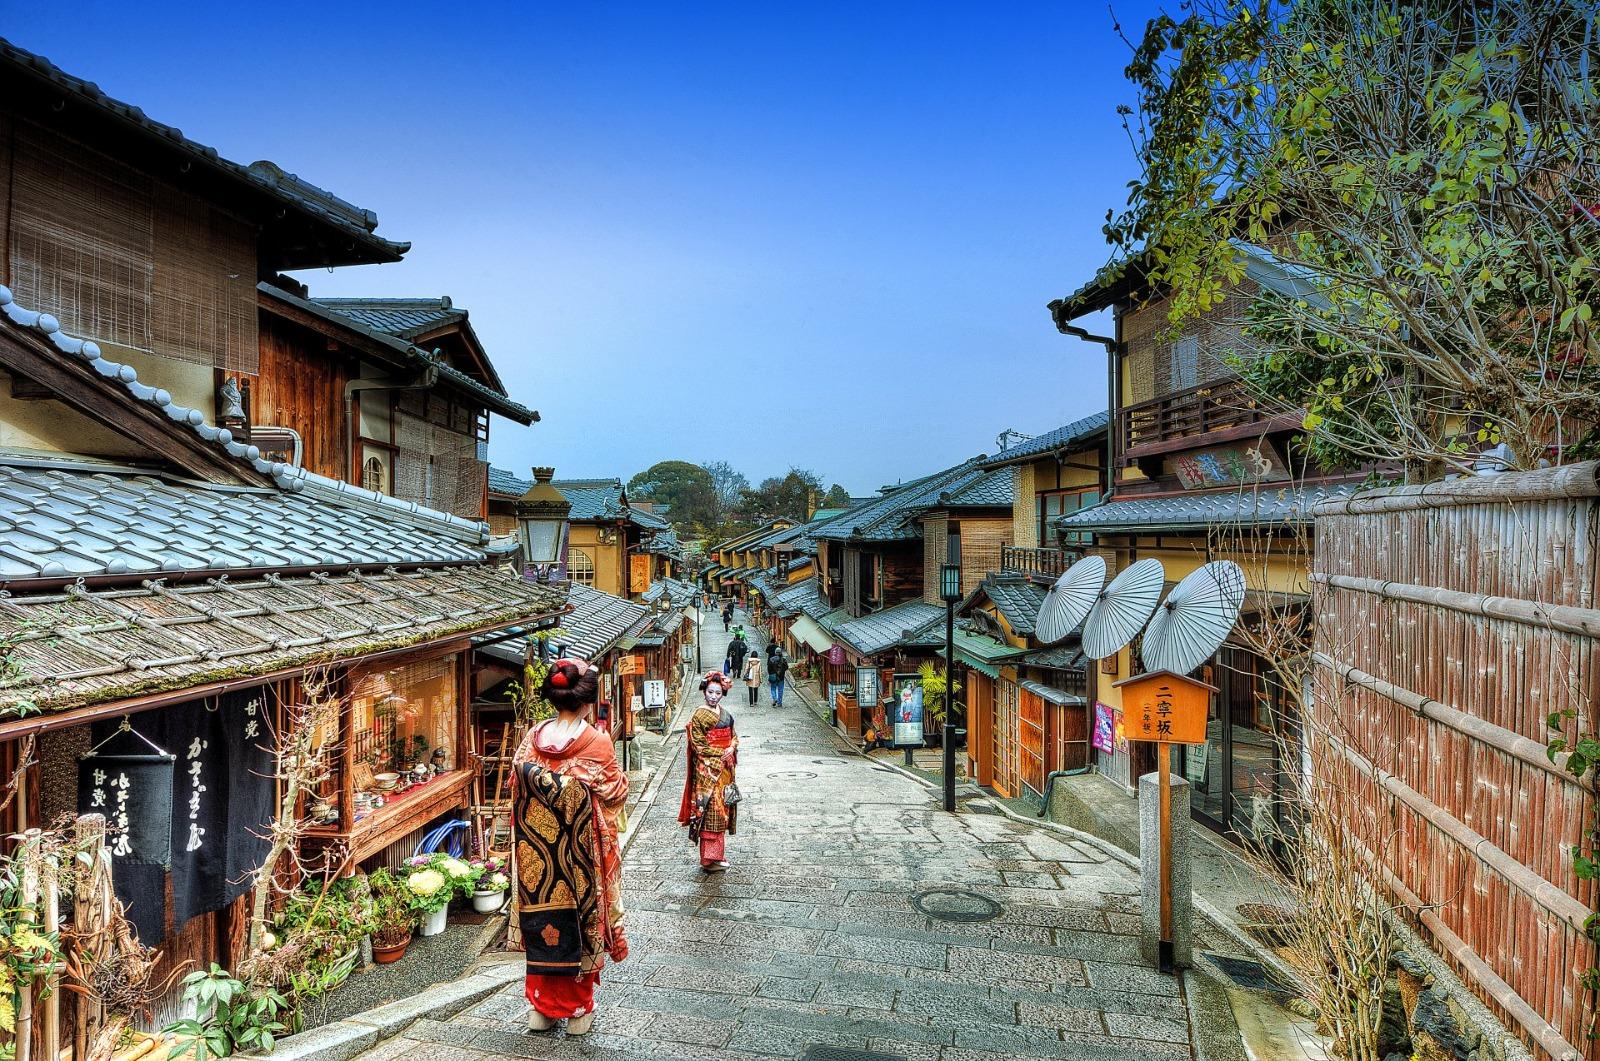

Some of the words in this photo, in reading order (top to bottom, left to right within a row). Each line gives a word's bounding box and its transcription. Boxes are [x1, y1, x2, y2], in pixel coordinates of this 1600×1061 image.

[245, 699, 260, 739] 甘党
[1155, 686, 1173, 735] 二寧坂
